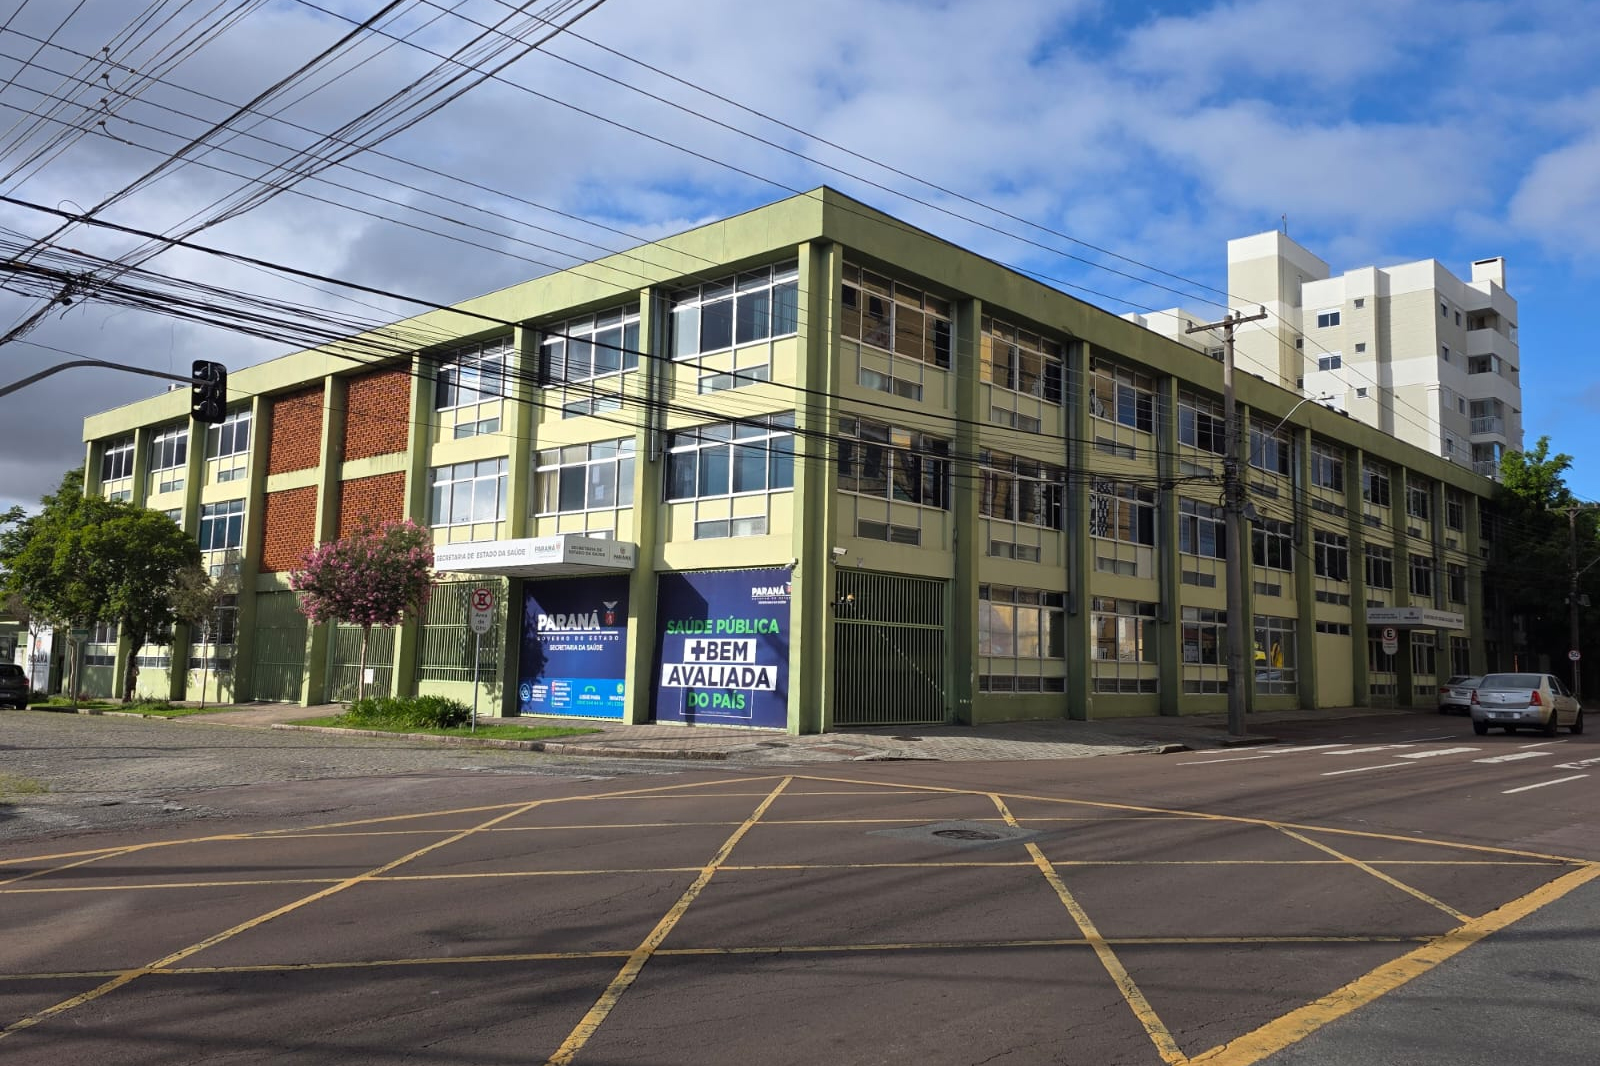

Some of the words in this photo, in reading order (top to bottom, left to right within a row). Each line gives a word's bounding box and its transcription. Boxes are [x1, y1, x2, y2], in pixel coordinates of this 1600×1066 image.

[436, 553, 466, 562] SECRETARIA
[476, 550, 497, 559] ESTADO
[498, 549, 506, 557] DA
[507, 547, 526, 556] SAÚDE
[752, 585, 785, 595] PARANÁ
[537, 609, 600, 631] PARANÁ
[666, 616, 713, 634] SAÚDE
[716, 615, 780, 634] PÚBLICA
[1387, 629, 1393, 637] E
[586, 643, 604, 651] SAÚDE
[691, 640, 748, 662] +BEM
[667, 665, 771, 689] AVALIADA
[688, 692, 709, 708] DO
[712, 690, 745, 710] PAÍS
